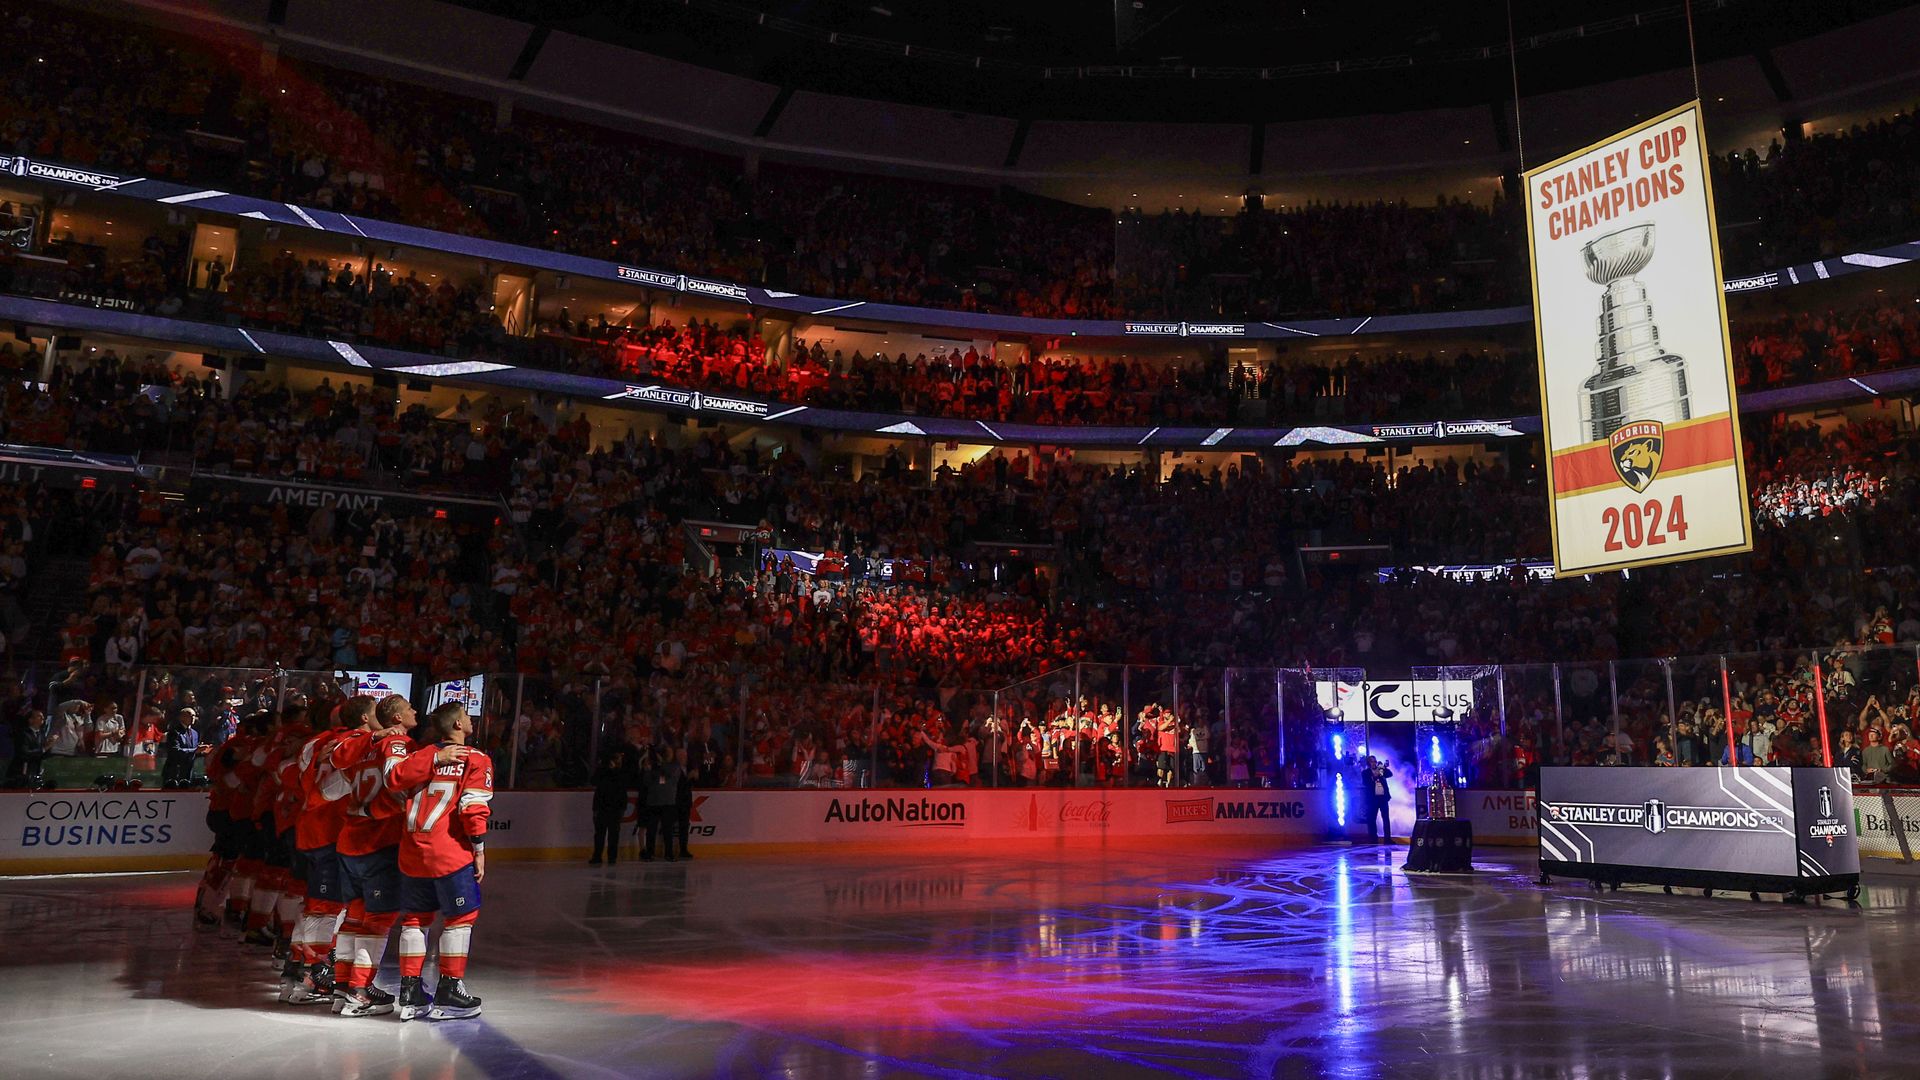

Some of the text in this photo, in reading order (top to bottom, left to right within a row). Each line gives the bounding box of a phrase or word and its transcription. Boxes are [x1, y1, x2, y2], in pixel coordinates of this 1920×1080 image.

[29, 164, 101, 185] CHAMPIONS
[1540, 125, 1687, 210] STANLEY CUP
[1548, 163, 1685, 241] CHAMPIONS
[625, 270, 660, 283] STANLEY
[660, 276, 675, 286] CUP
[687, 281, 735, 296] CHAMPIONS
[1132, 325, 1163, 333] STANLEY
[1189, 326, 1234, 334] CHAMPIONS
[633, 390, 672, 402] STANLEY
[672, 394, 689, 404] CUP
[703, 398, 755, 413] CHAMPIONS
[1380, 427, 1417, 437] STANLEY
[1417, 427, 1433, 435] CUP
[1446, 422, 1500, 434] CHAMPIONS
[1613, 425, 1658, 444] FLORIDA
[1601, 494, 1689, 553] 2024
[1401, 694, 1470, 708] CELSUS
[26, 799, 176, 821] COMCAST
[406, 781, 458, 833] 17
[824, 797, 965, 823] AutoNation
[1172, 801, 1305, 819] MIKE'S AMAZING
[1561, 807, 1784, 828] STANLEY CUP CHAMPIONS 2024
[22, 824, 172, 847] BUSINESS
[1809, 825, 1848, 836] CHAMPIONS
